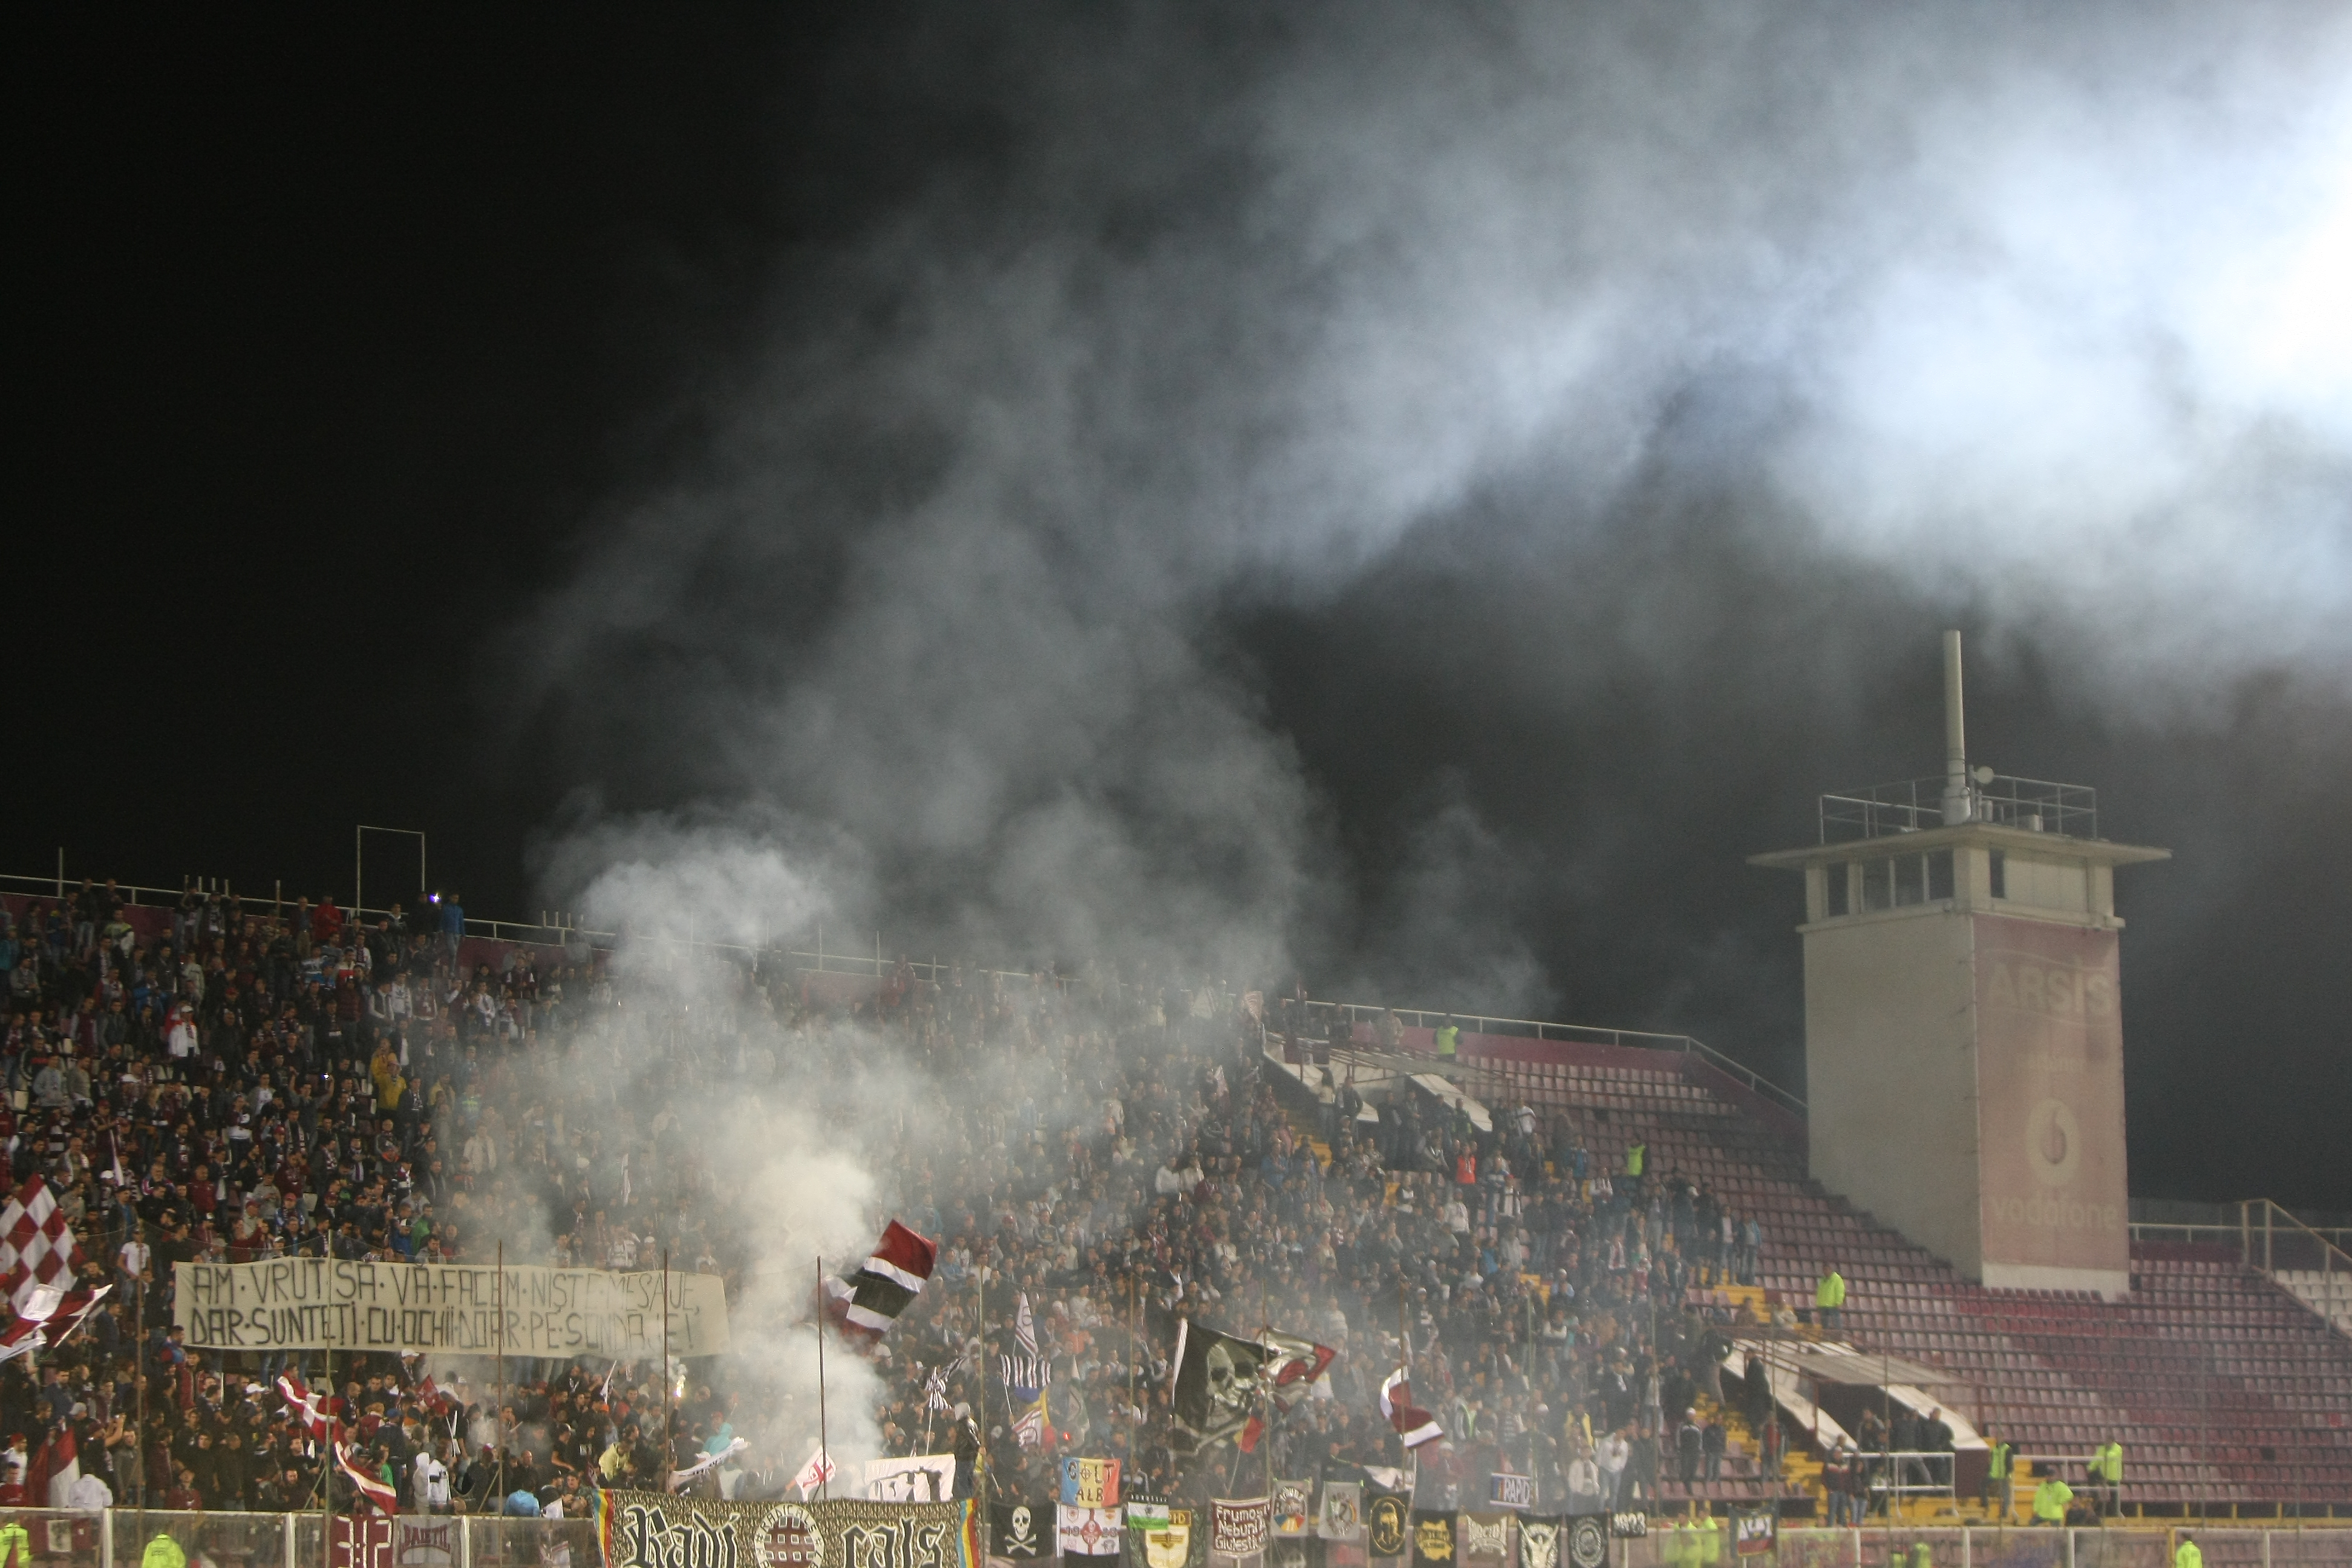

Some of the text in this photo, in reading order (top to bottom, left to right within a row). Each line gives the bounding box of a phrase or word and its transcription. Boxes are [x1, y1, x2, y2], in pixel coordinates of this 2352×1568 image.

[1988, 1191, 2118, 1230] vodafone
[193, 1266, 235, 1304] AM
[250, 1259, 325, 1303] VRUT
[191, 1306, 246, 1346] DAR
[1074, 1486, 1105, 1502] ALB
